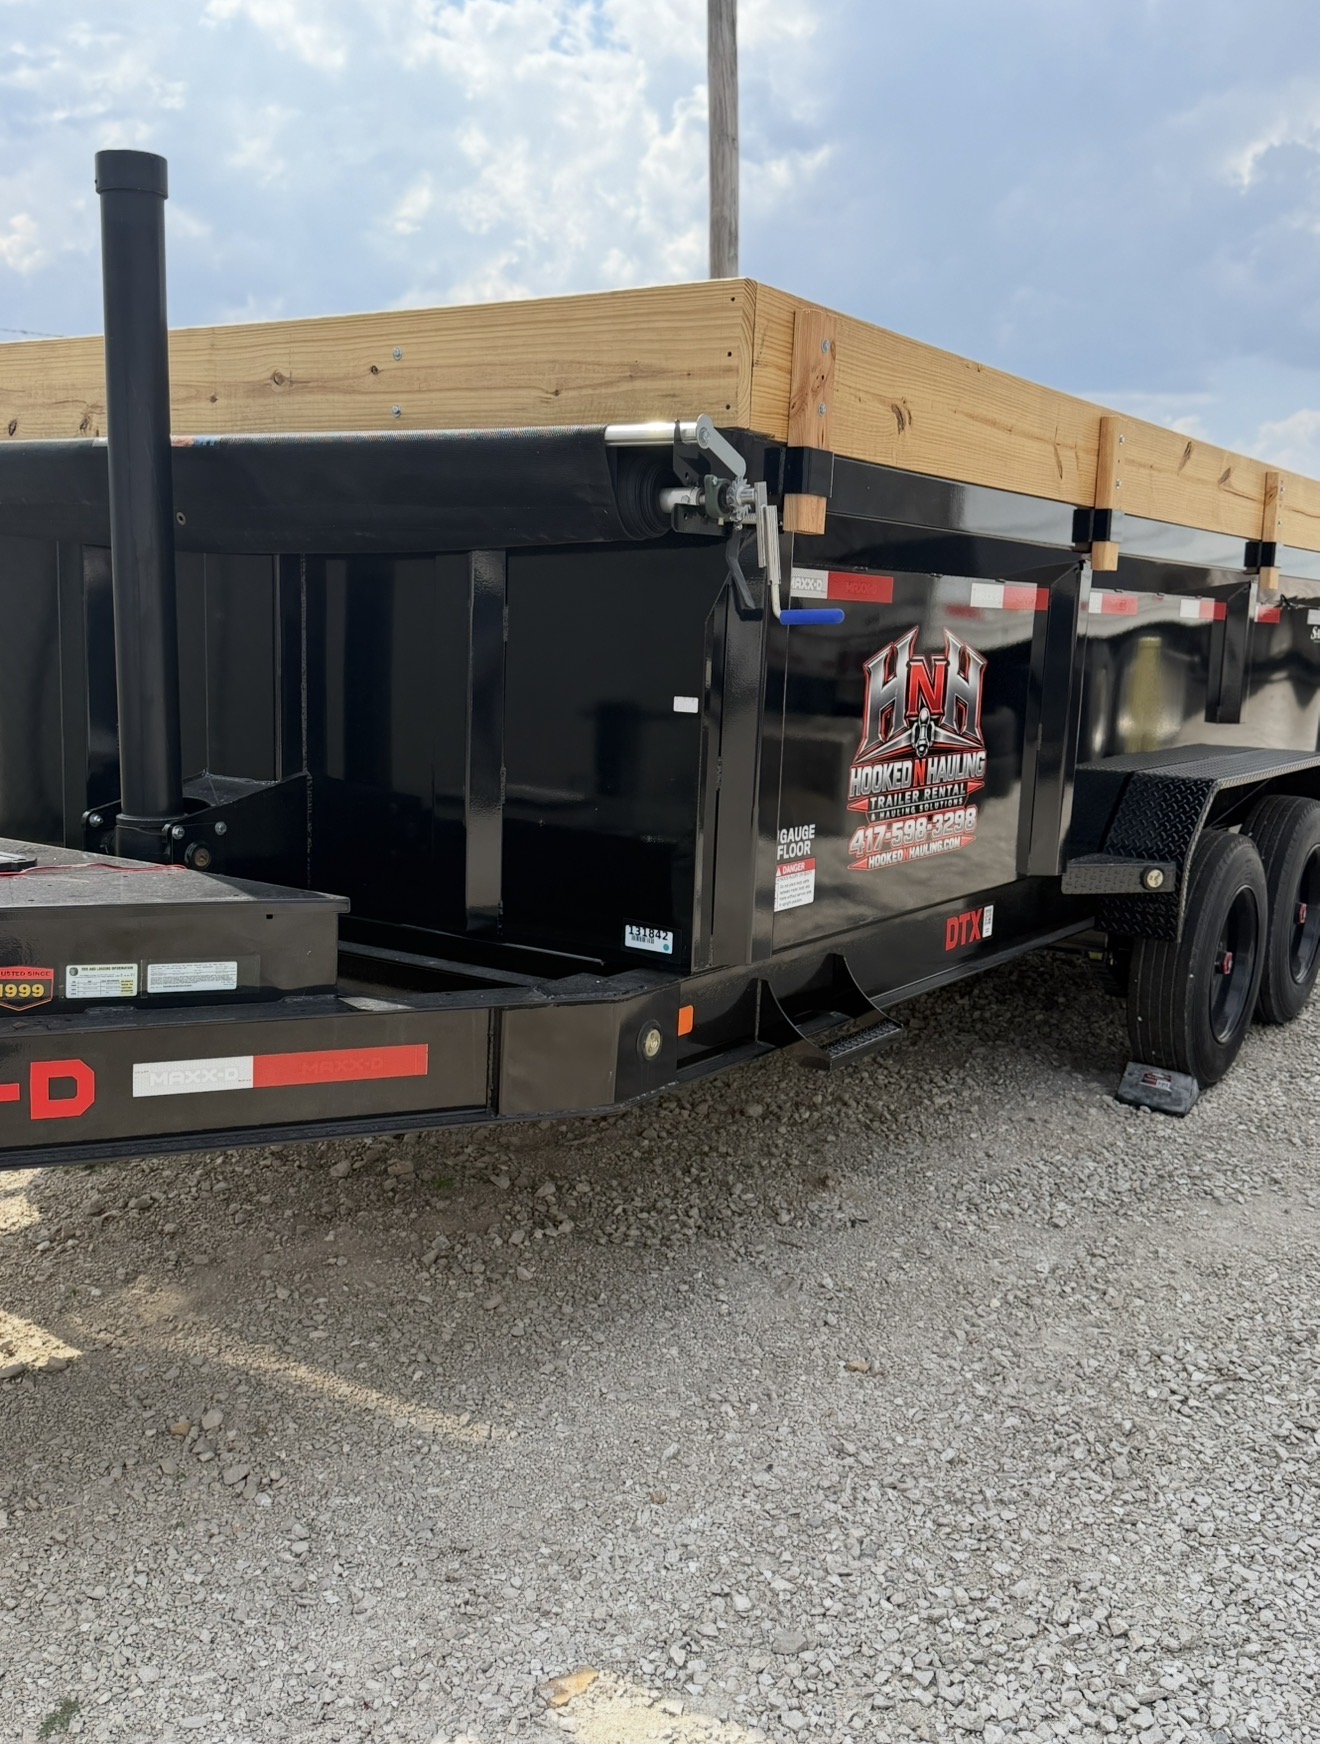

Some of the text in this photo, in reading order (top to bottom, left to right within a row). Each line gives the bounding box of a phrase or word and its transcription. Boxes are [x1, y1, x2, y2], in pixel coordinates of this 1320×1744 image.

[870, 783, 966, 810] TRAILER RENTAL
[880, 806, 916, 819] HAULING
[919, 798, 963, 812] SOLUTIONS
[780, 824, 816, 843] GAUGE
[849, 807, 977, 857] 417-598-3298
[777, 840, 811, 860] FLOOR
[782, 862, 806, 875] DANGER
[628, 925, 669, 941] 131842
[945, 908, 983, 951] DTX
[149, 1066, 240, 1087] MAXX-D
